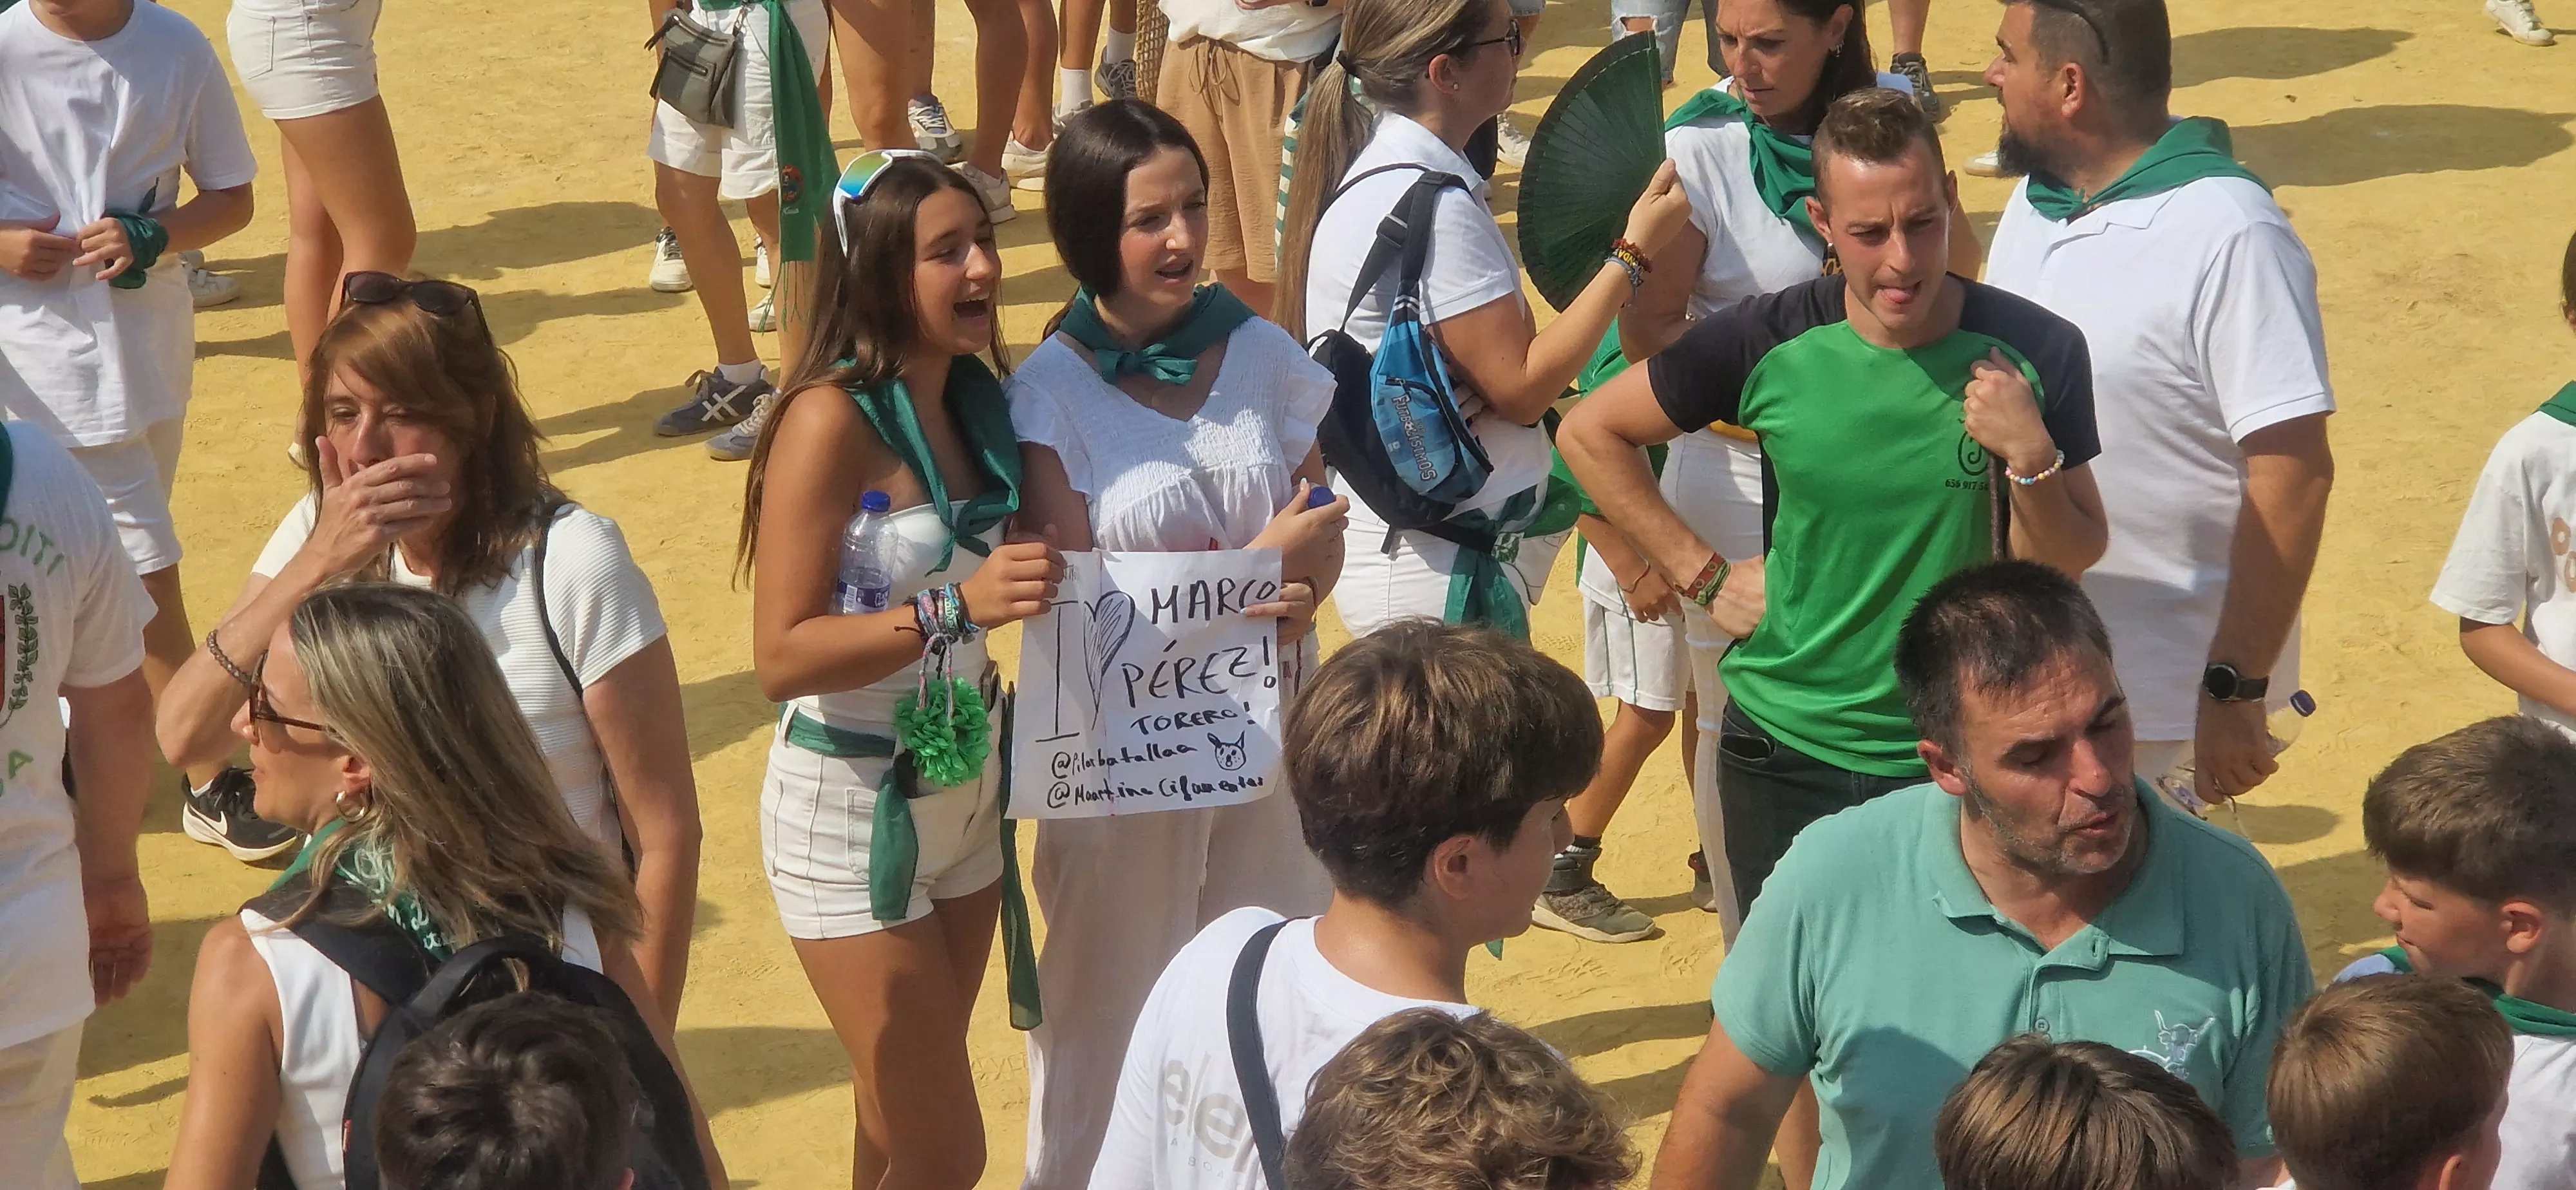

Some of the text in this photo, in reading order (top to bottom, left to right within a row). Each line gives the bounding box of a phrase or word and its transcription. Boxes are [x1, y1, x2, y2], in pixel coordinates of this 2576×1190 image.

[1034, 578, 1278, 742] I MARCO
[1121, 635, 1277, 708] PÉREZ!
[1130, 701, 1255, 735] TORERO!
